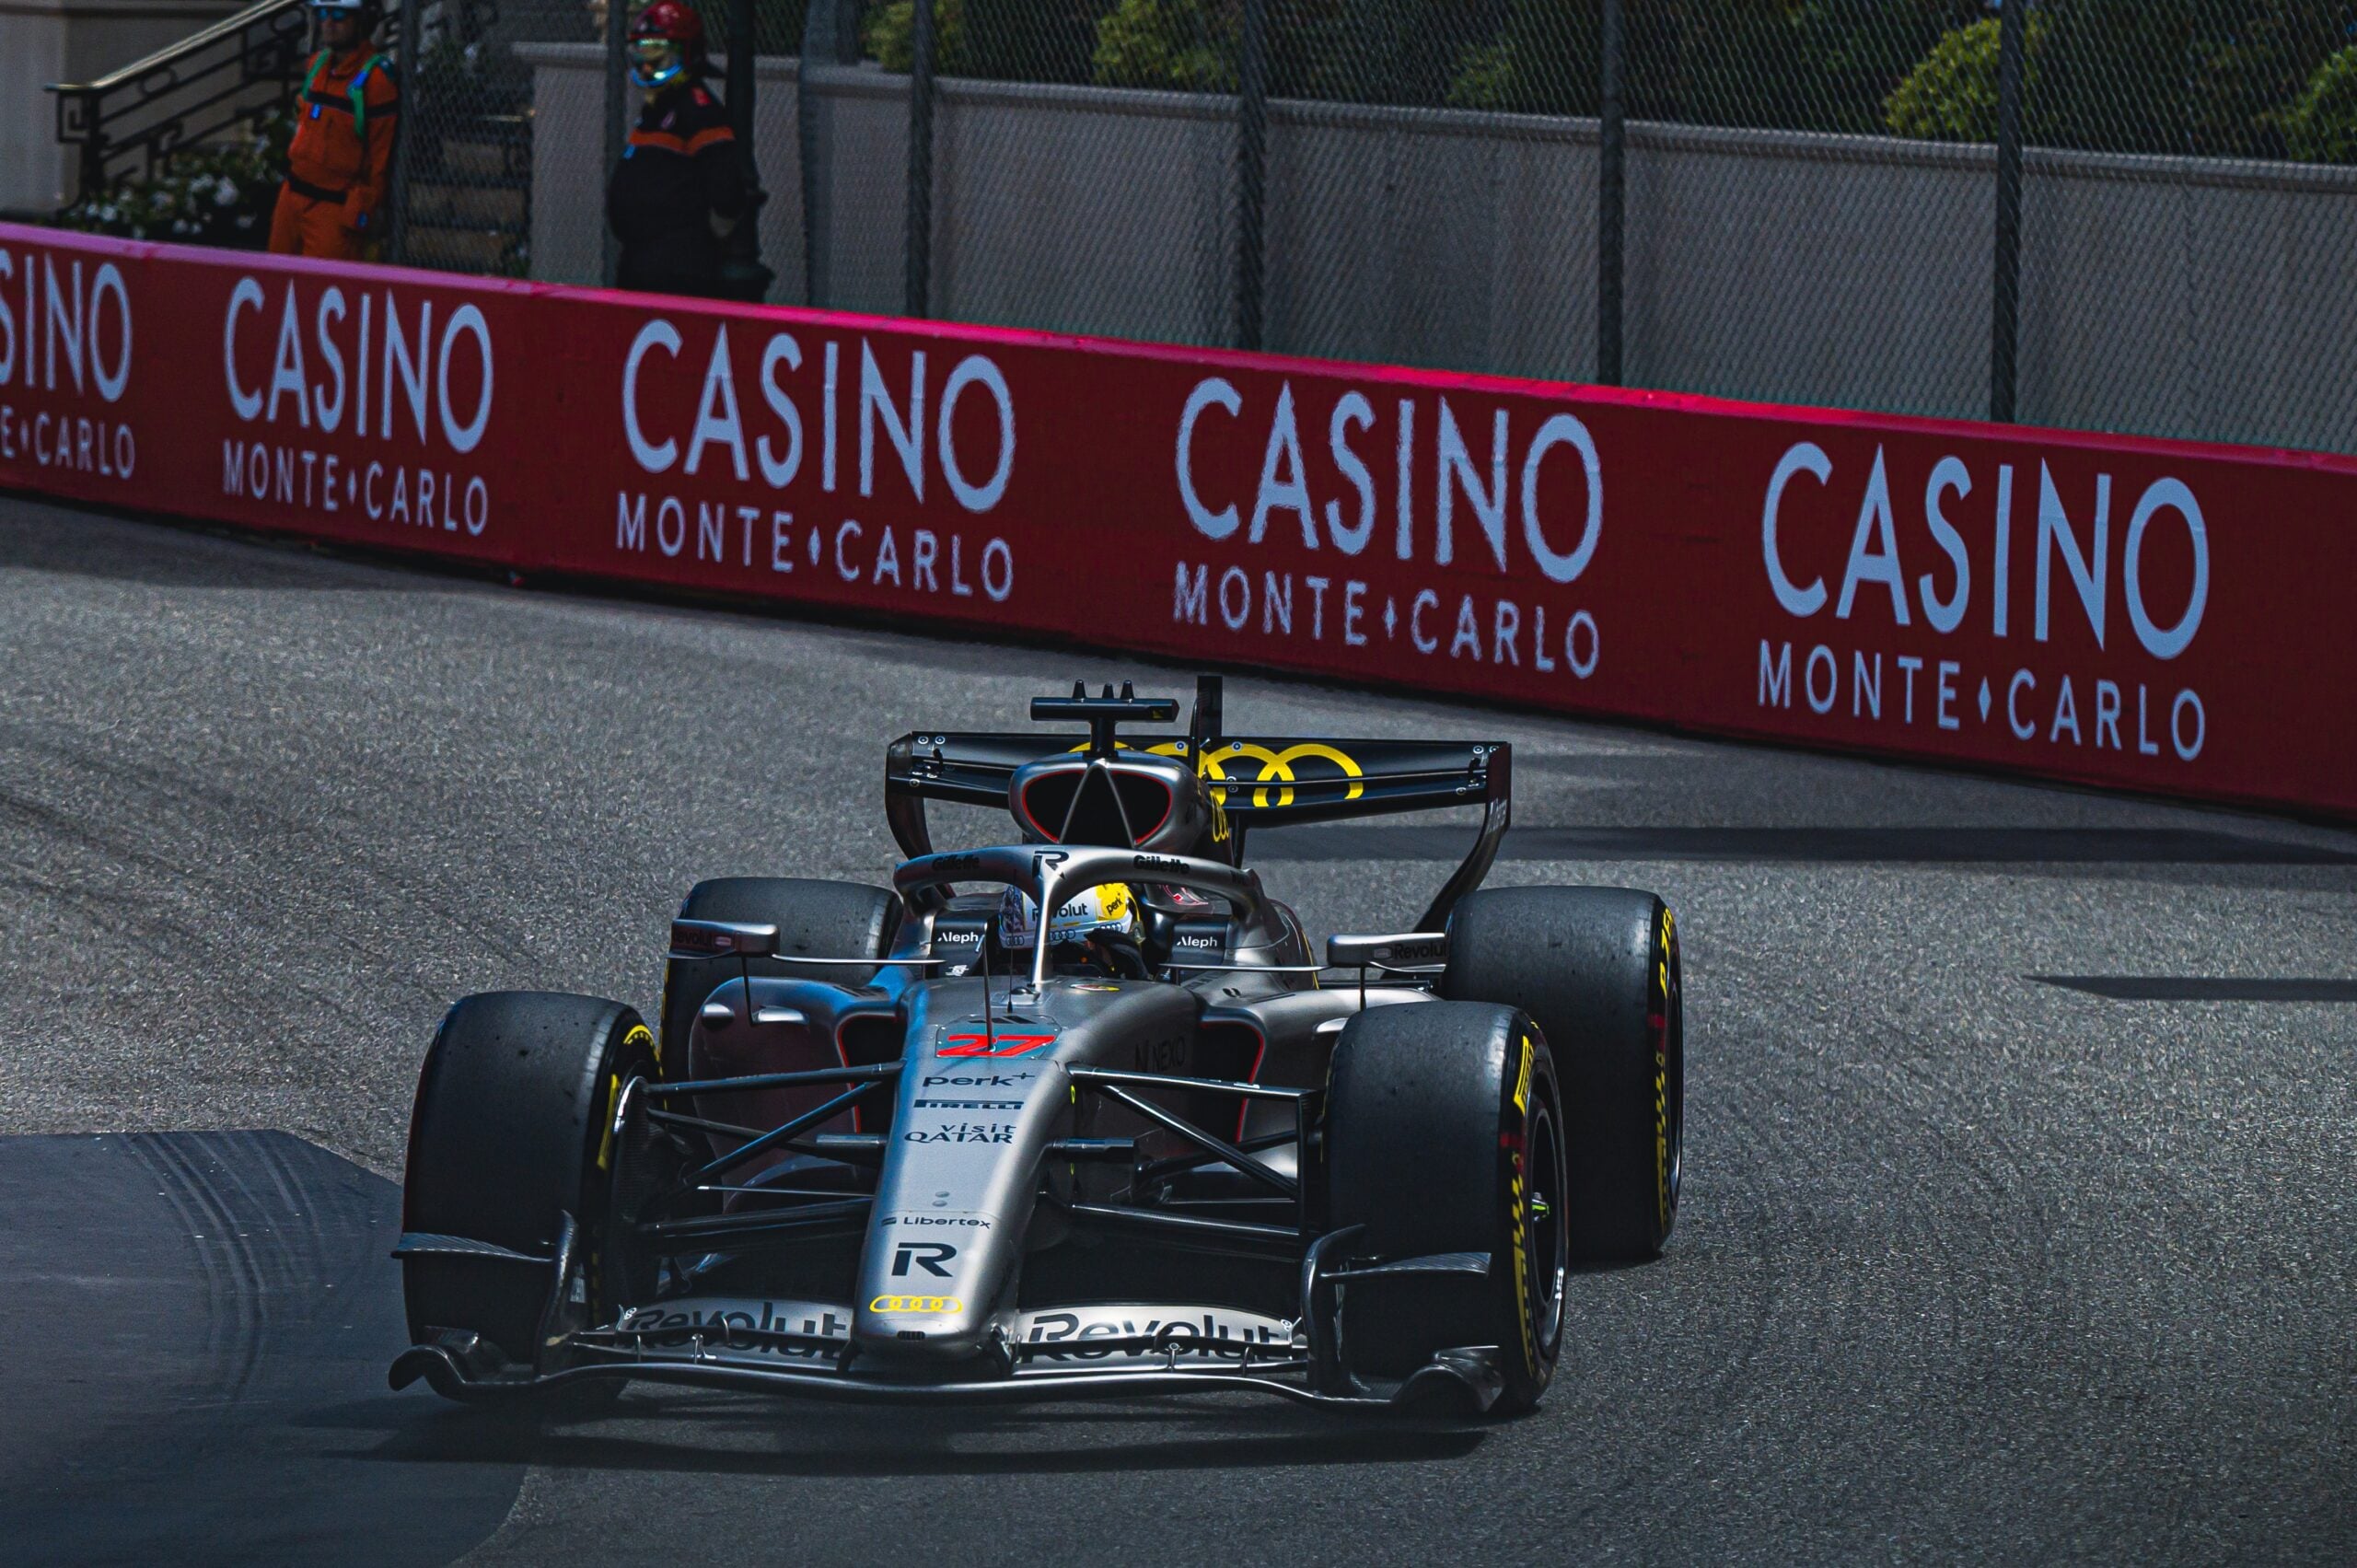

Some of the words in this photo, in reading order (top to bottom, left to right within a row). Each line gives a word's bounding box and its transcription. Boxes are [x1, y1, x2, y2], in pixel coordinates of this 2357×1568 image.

[224, 277, 494, 453] CASINO
[622, 319, 1016, 514] CASINO
[34, 412, 135, 480] CARLO
[223, 438, 339, 512] MONTE
[365, 460, 489, 536] CARLO
[1174, 376, 1604, 583] CASINO
[616, 491, 795, 573] MONTE
[835, 519, 1013, 602] CARLO
[1760, 441, 2210, 660] CASINO
[1172, 561, 1368, 645] MONTE
[1411, 588, 1600, 679] CARLO
[1758, 639, 1961, 730] MONTE
[2007, 668, 2206, 761] CARLO
[932, 854, 980, 872] Gillette
[1133, 854, 1190, 875] Gillette
[937, 932, 979, 944] Aleph
[1177, 935, 1217, 948] Aleph
[936, 1034, 1056, 1057] 27
[913, 1098, 1024, 1110] PIRELLI
[904, 1132, 1013, 1144] QATAR
[940, 1122, 1017, 1134] visit
[903, 1216, 992, 1229] Libertex
[890, 1242, 958, 1278] R
